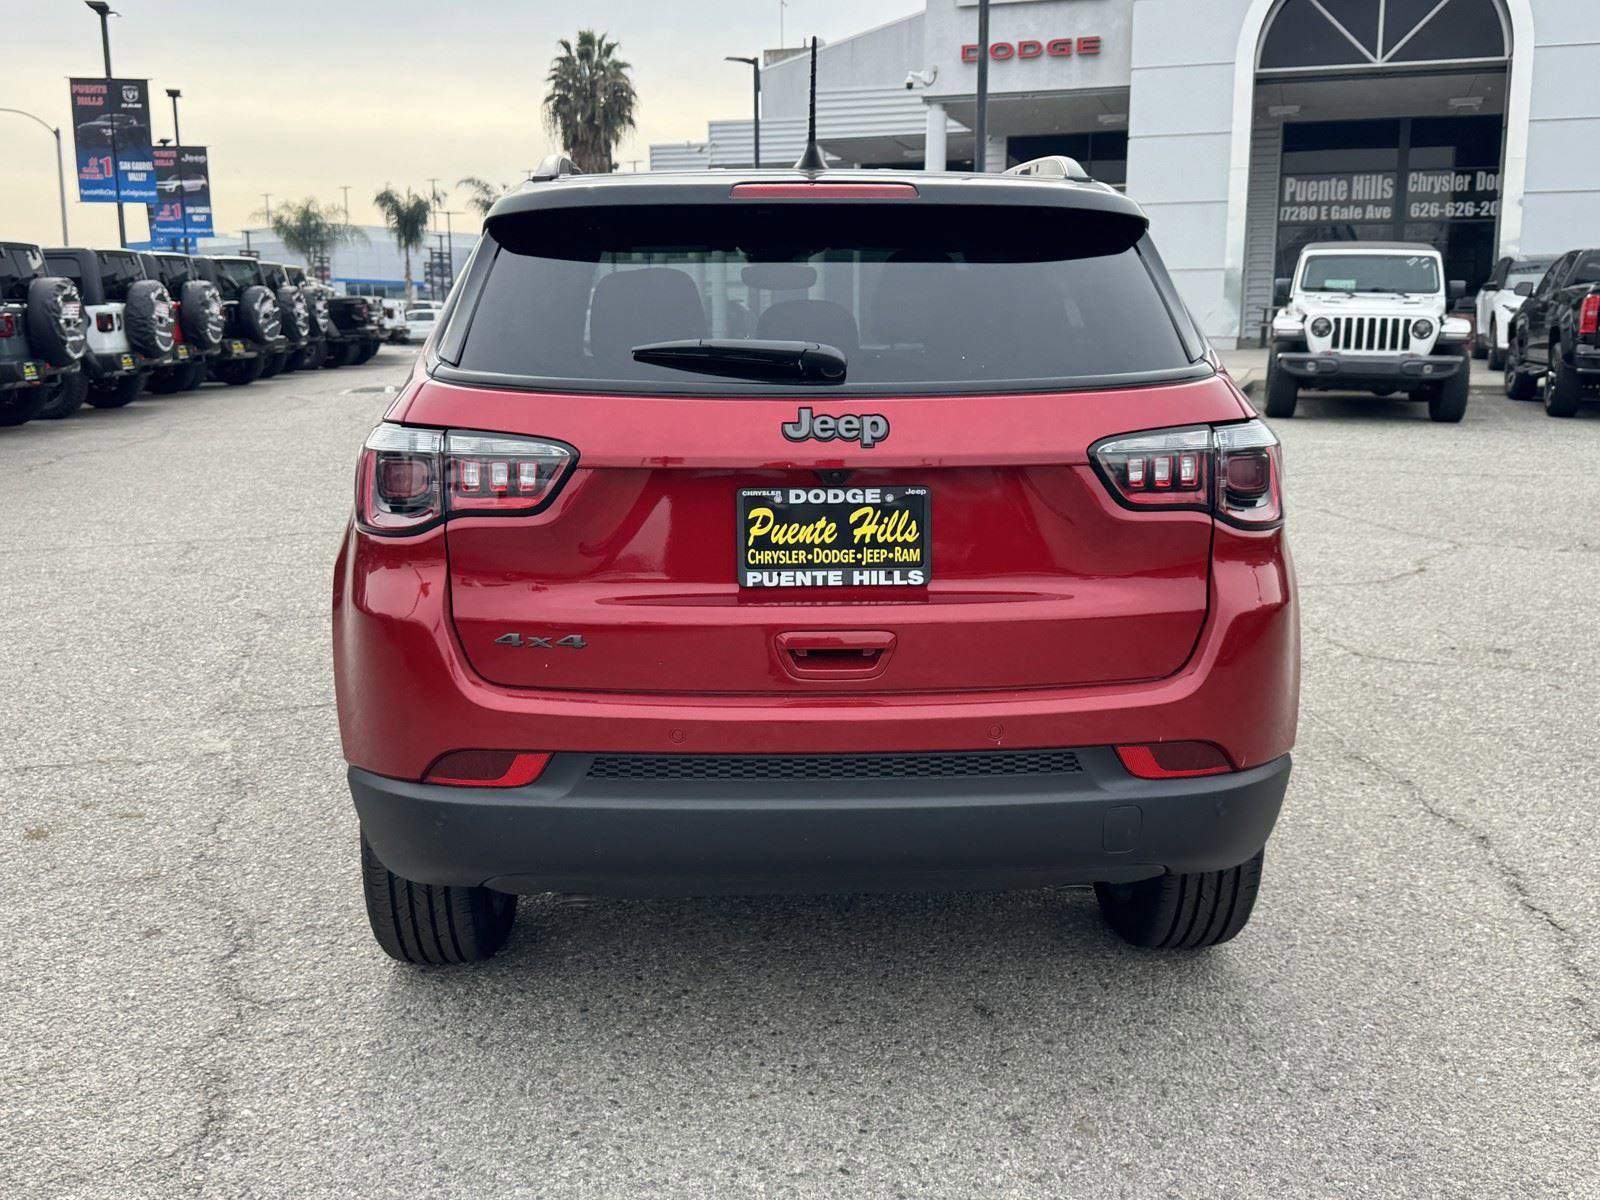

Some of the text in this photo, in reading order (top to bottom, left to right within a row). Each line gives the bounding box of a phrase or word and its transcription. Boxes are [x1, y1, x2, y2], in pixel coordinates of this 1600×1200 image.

[961, 36, 1101, 63] DODGE
[181, 153, 206, 163] Jeep
[1284, 177, 1348, 202] Puente
[1352, 174, 1394, 200] Hills
[1408, 171, 1471, 194] Chrysler
[1320, 205, 1328, 220] E
[1330, 205, 1362, 220] Gale
[1365, 204, 1392, 219] Ave
[781, 407, 890, 448] Jeep
[789, 489, 882, 504] DODGE
[748, 506, 920, 547] Puente Hills
[746, 570, 924, 587] PUENTE HILLS
